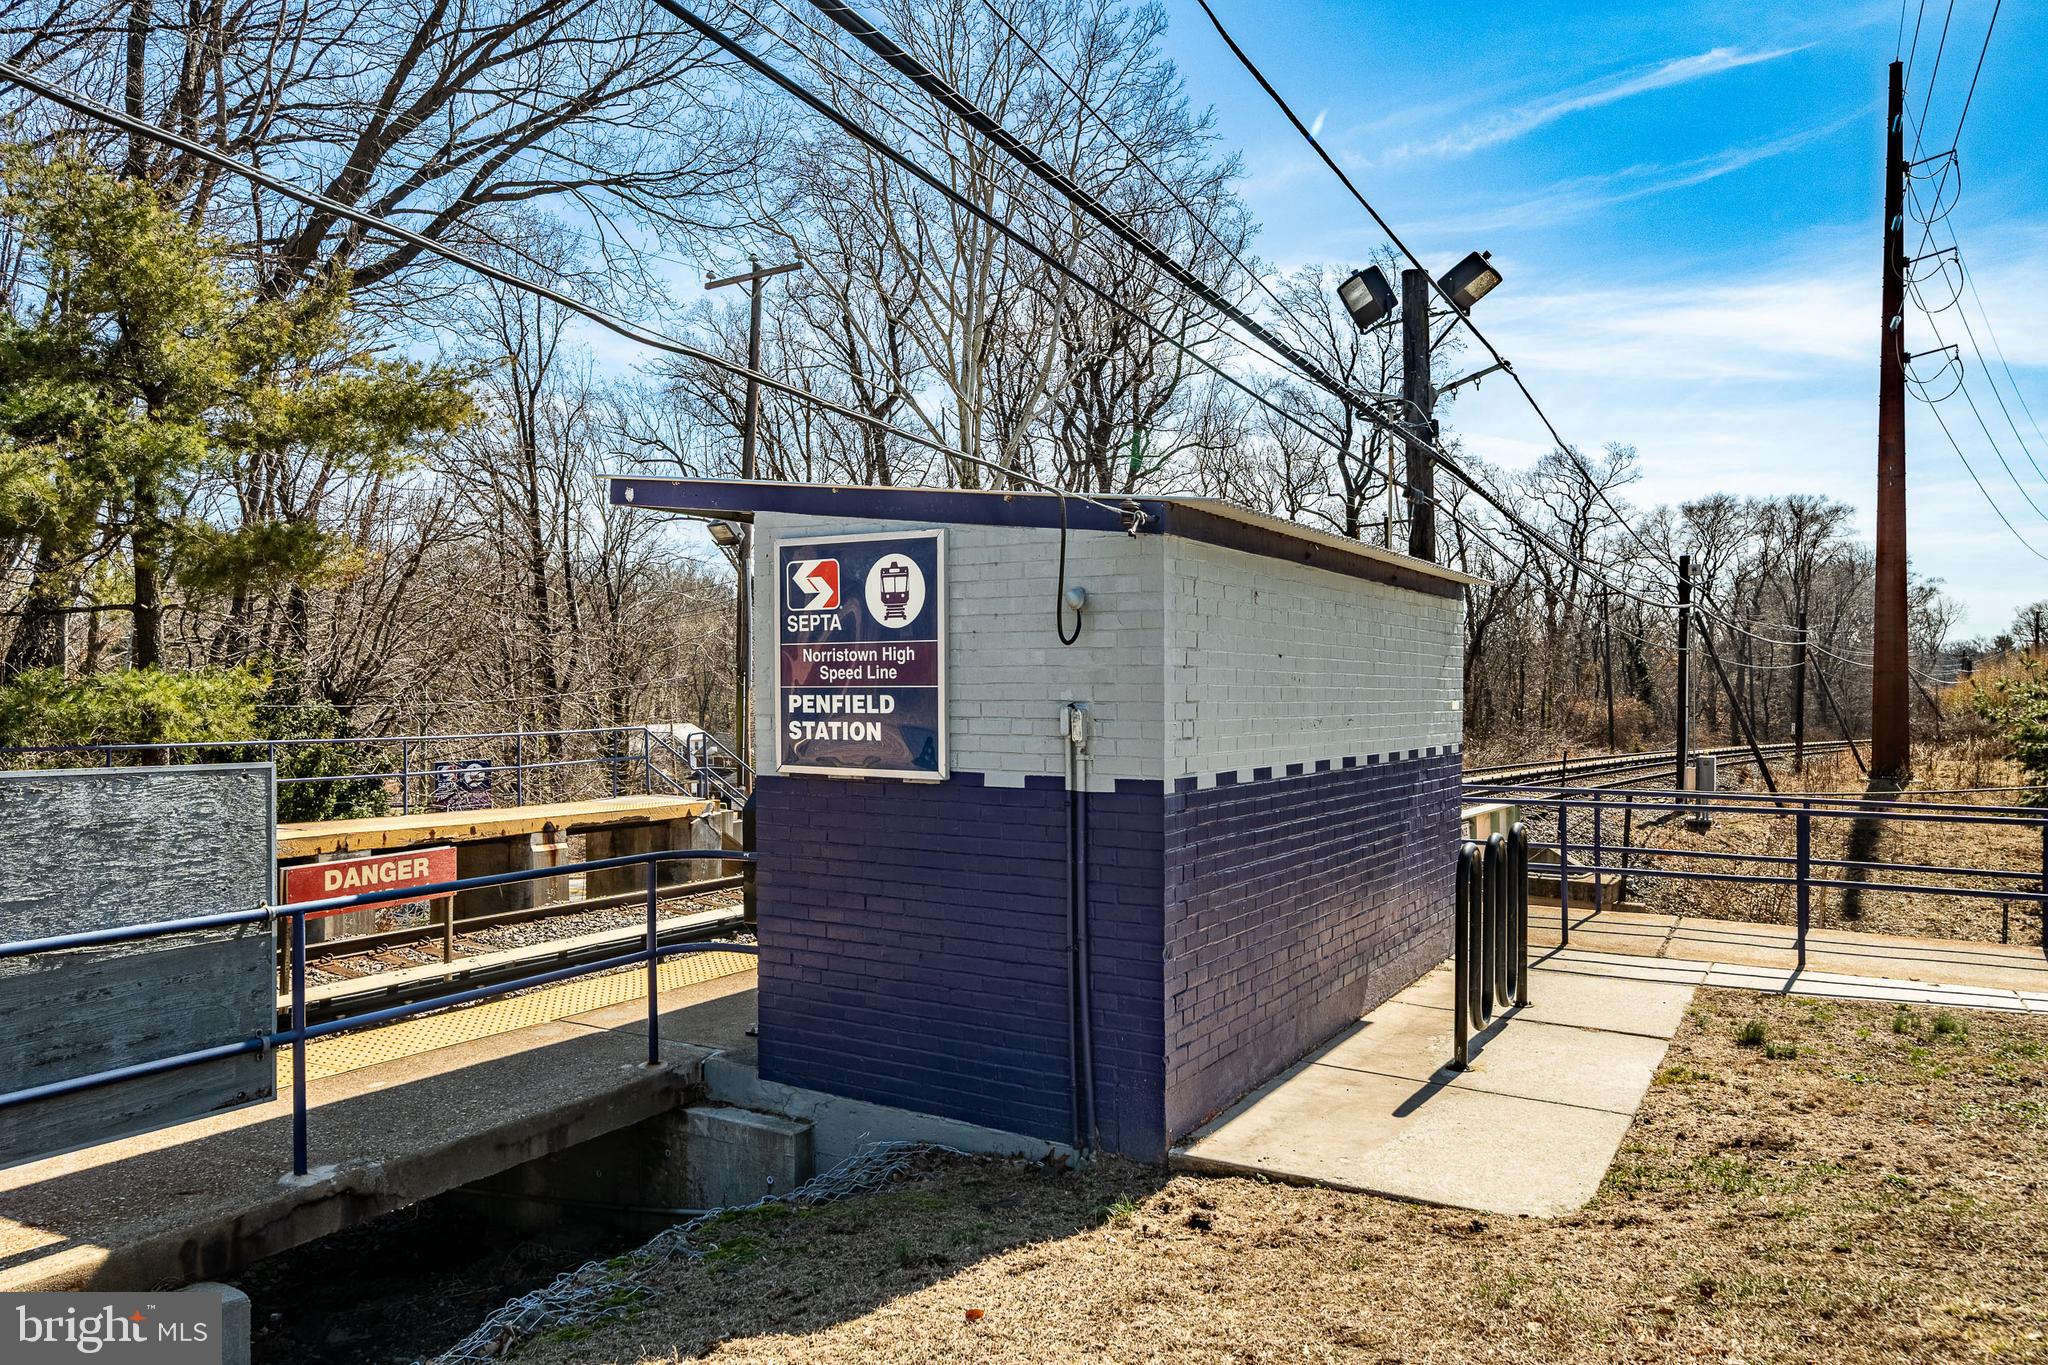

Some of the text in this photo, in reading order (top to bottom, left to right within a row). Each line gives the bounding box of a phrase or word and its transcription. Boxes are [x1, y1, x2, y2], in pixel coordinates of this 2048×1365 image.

[787, 614, 842, 632] SEPTA
[802, 646, 915, 664] Norristown High
[819, 665, 897, 682] Speed Line
[788, 694, 895, 714] PENFIELD
[788, 721, 881, 741] STATION
[324, 857, 430, 892] DANGER
